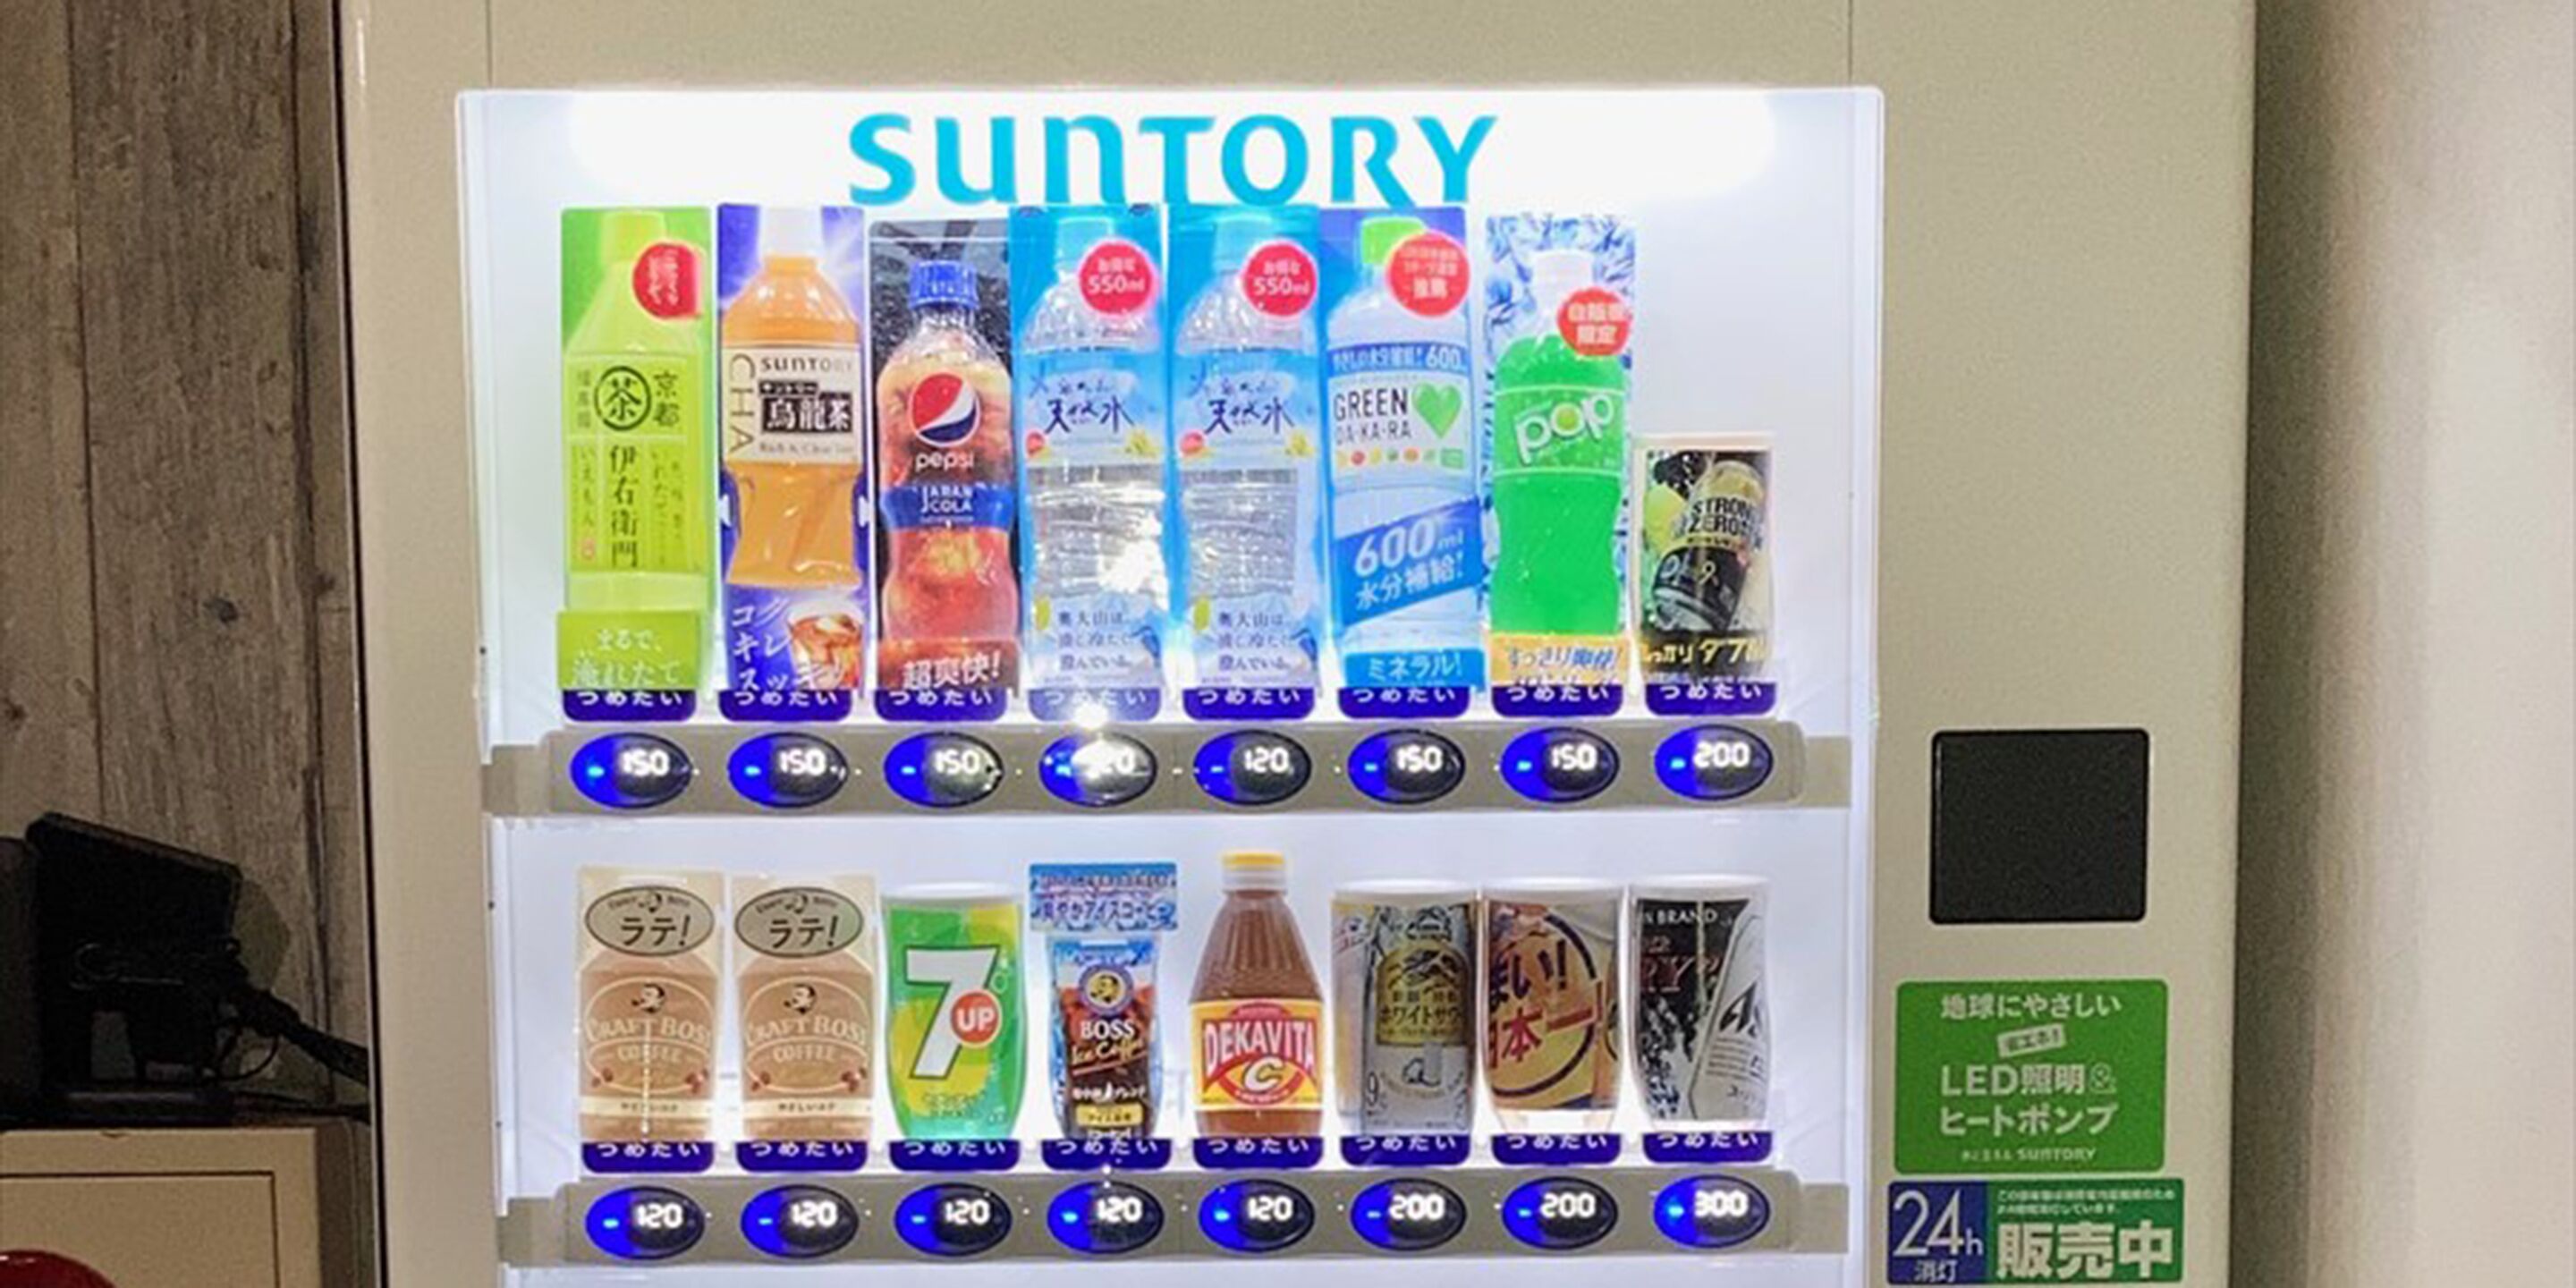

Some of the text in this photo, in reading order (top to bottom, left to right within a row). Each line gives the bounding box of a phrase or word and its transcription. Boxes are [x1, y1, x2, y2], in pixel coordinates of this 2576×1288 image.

[849, 113, 1499, 208] SUNTORY
[1089, 275, 1146, 293] 550ml
[1254, 276, 1309, 294] 550ml
[605, 377, 641, 419] 茶
[729, 354, 756, 453] CHA
[1334, 388, 1408, 422] GREEN
[915, 451, 974, 470] pepsi
[609, 445, 638, 568] 伊右衛門
[931, 499, 973, 513] COLA
[902, 650, 1002, 690] 超爽快!
[623, 750, 670, 775] 150
[780, 750, 827, 775] 150
[935, 749, 982, 775] 150
[1244, 747, 1289, 772] 120
[1395, 746, 1443, 772] 150
[1550, 744, 1597, 771] 150
[1693, 741, 1751, 768] 200
[622, 916, 691, 946] ラテ!
[770, 916, 839, 949] ラテ!
[1941, 992, 2123, 1021] 地球にやさしい
[956, 1009, 996, 1032] UP
[1080, 1020, 1135, 1039] BOSS
[772, 1044, 837, 1063] COFFEE
[1204, 1021, 1316, 1079] DEKAVITA
[1941, 1103, 2120, 1136] ヒートポンプ
[2017, 1148, 2097, 1162] SUNTORY
[637, 1201, 683, 1228] 120
[791, 1200, 837, 1227] 120
[944, 1199, 990, 1225] 120
[1096, 1197, 1143, 1223] 120
[1248, 1195, 1293, 1221] 120
[1389, 1193, 1445, 1220] 200
[1540, 1191, 1597, 1218] 200
[1692, 1190, 1749, 1217] 300
[1893, 1189, 1984, 1257] 24h
[1996, 1219, 2174, 1279] 販売中
